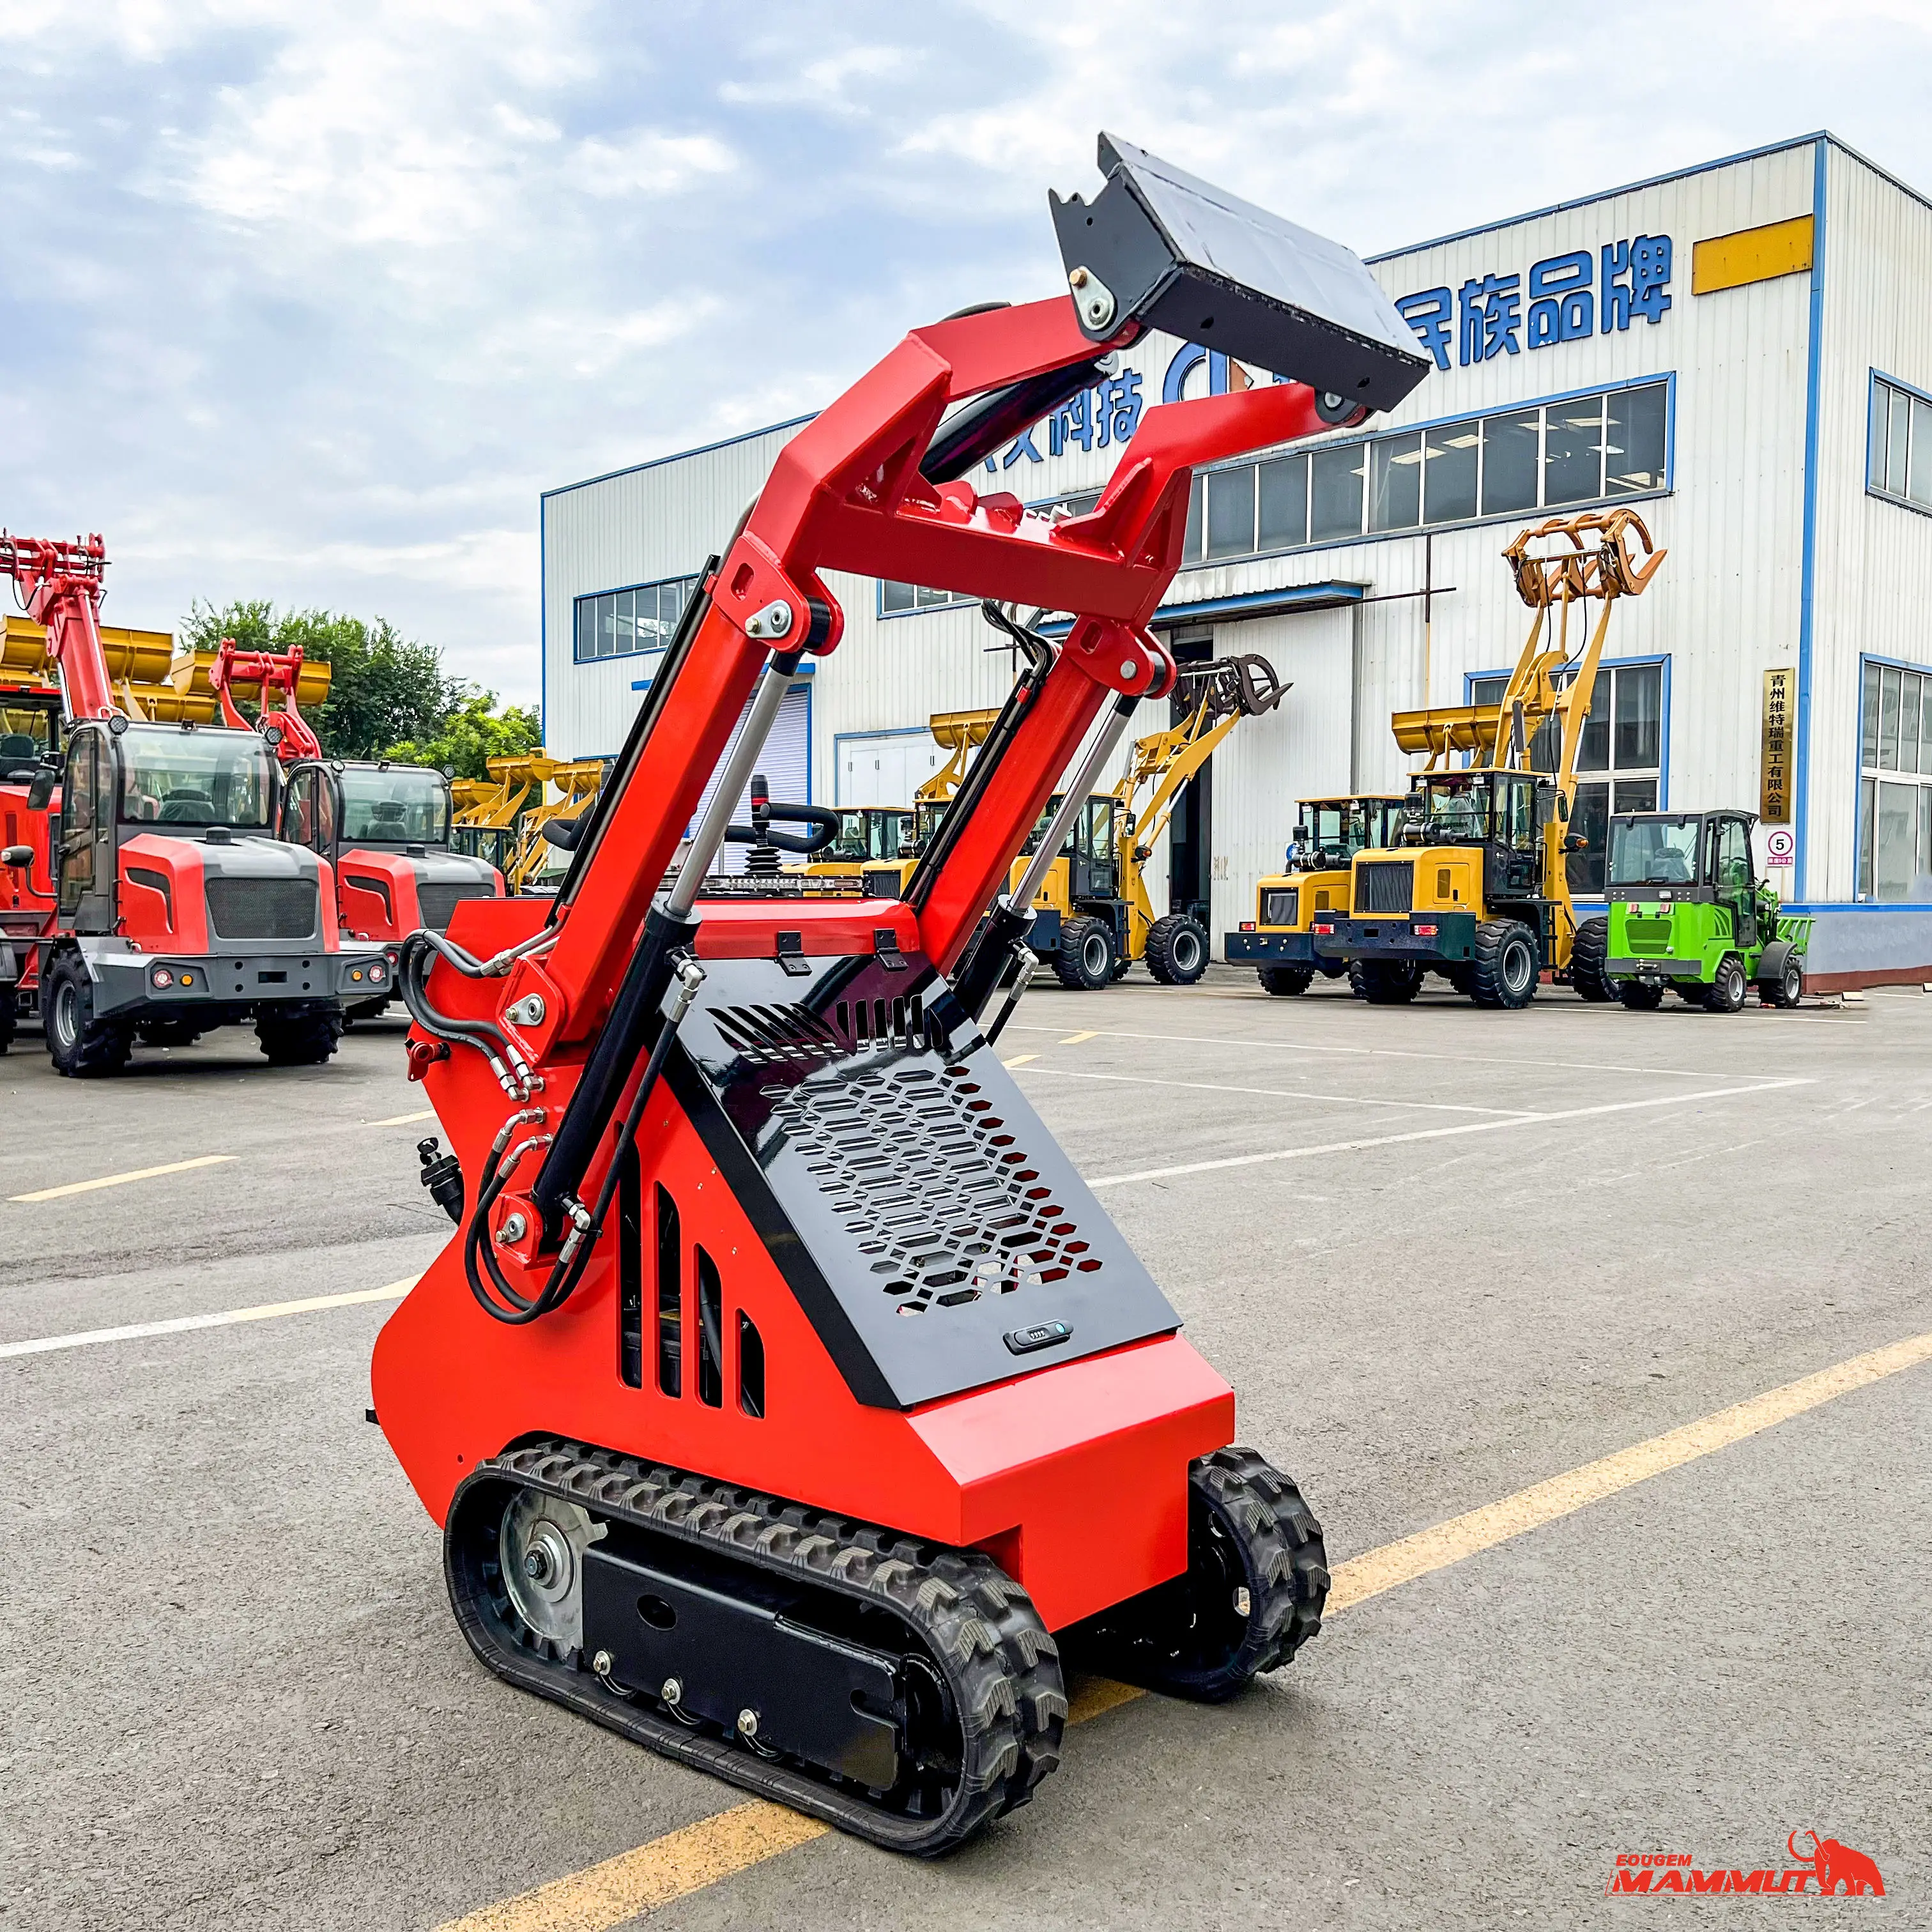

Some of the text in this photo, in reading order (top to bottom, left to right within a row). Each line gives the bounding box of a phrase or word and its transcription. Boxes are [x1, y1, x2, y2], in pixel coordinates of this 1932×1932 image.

[1394, 234, 1673, 370] 民族品牌
[1767, 675, 1786, 816] 青州维特瑞重工有限公司
[1775, 838, 1784, 850] 5
